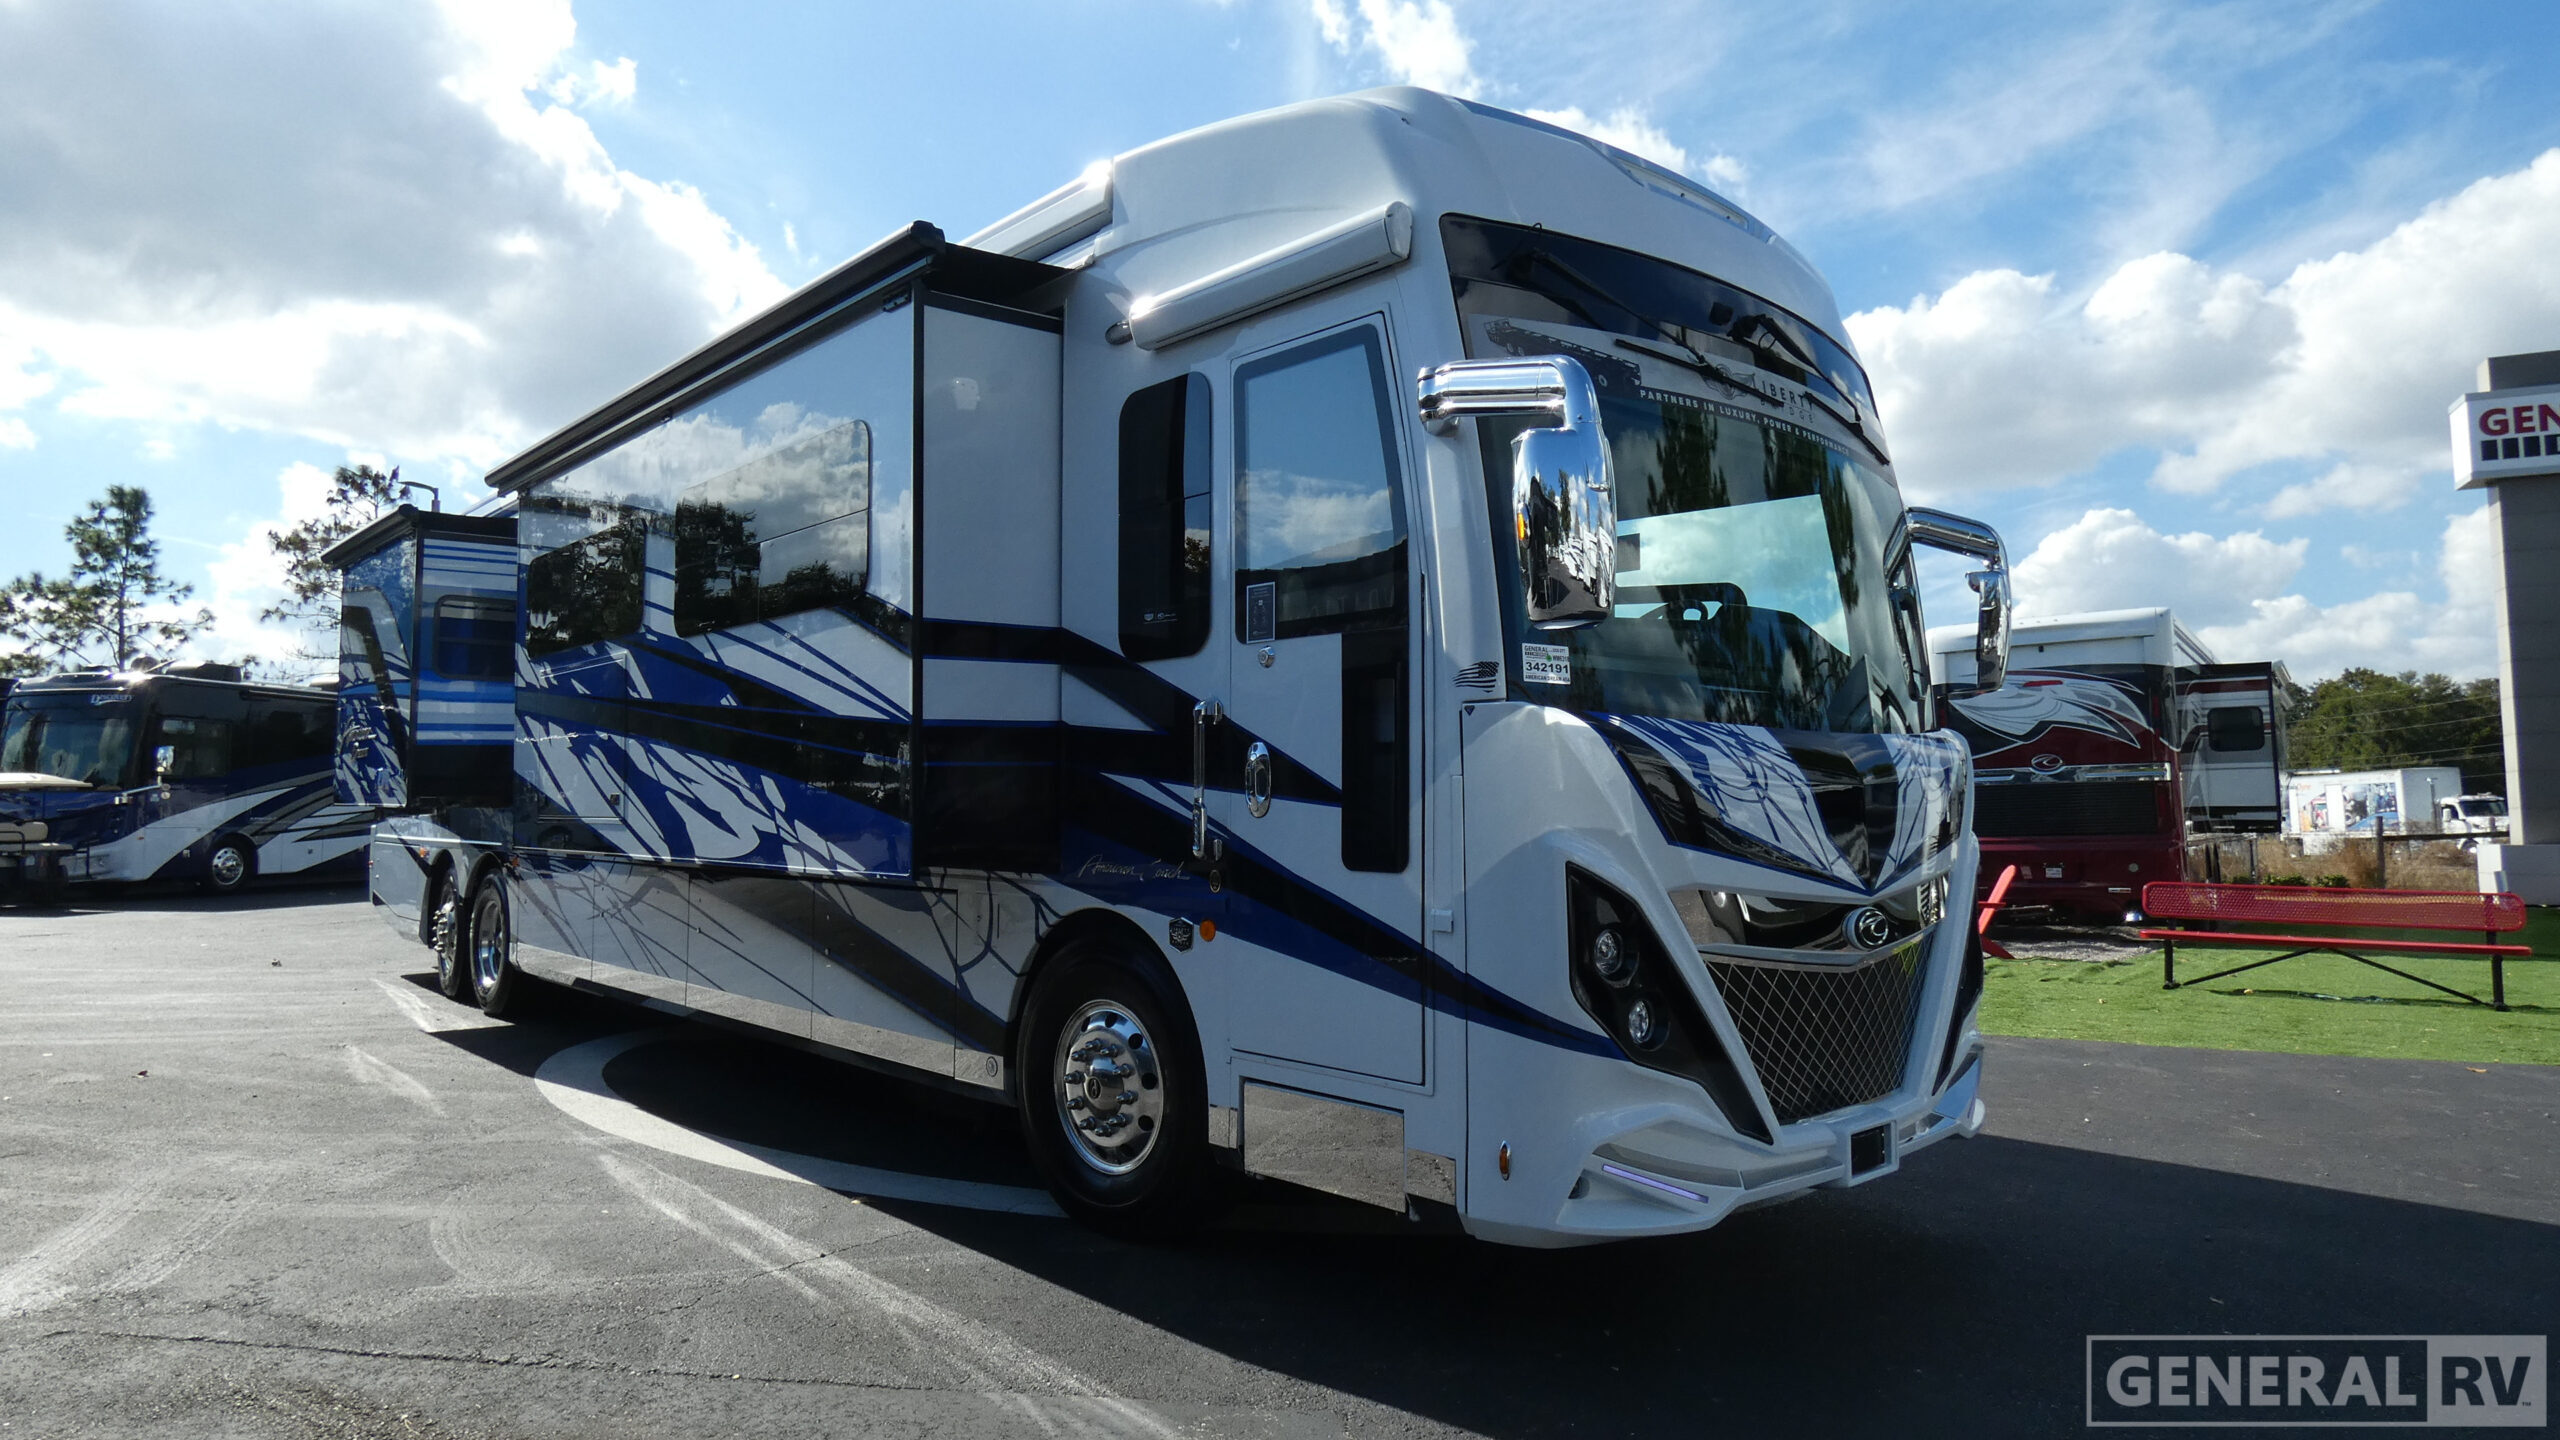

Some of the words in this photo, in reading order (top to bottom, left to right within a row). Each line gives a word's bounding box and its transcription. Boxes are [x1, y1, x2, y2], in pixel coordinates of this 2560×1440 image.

[1640, 389, 1698, 408] PARTNERS
[1703, 402, 1715, 413] IN
[1719, 405, 1760, 424] LUXURY,
[1764, 417, 1791, 433] POWER
[1795, 427, 1800, 436] &
[1802, 430, 1849, 457] PERFORMANCE
[1524, 645, 1548, 653] GENERAL
[1525, 661, 1568, 674] 342191
